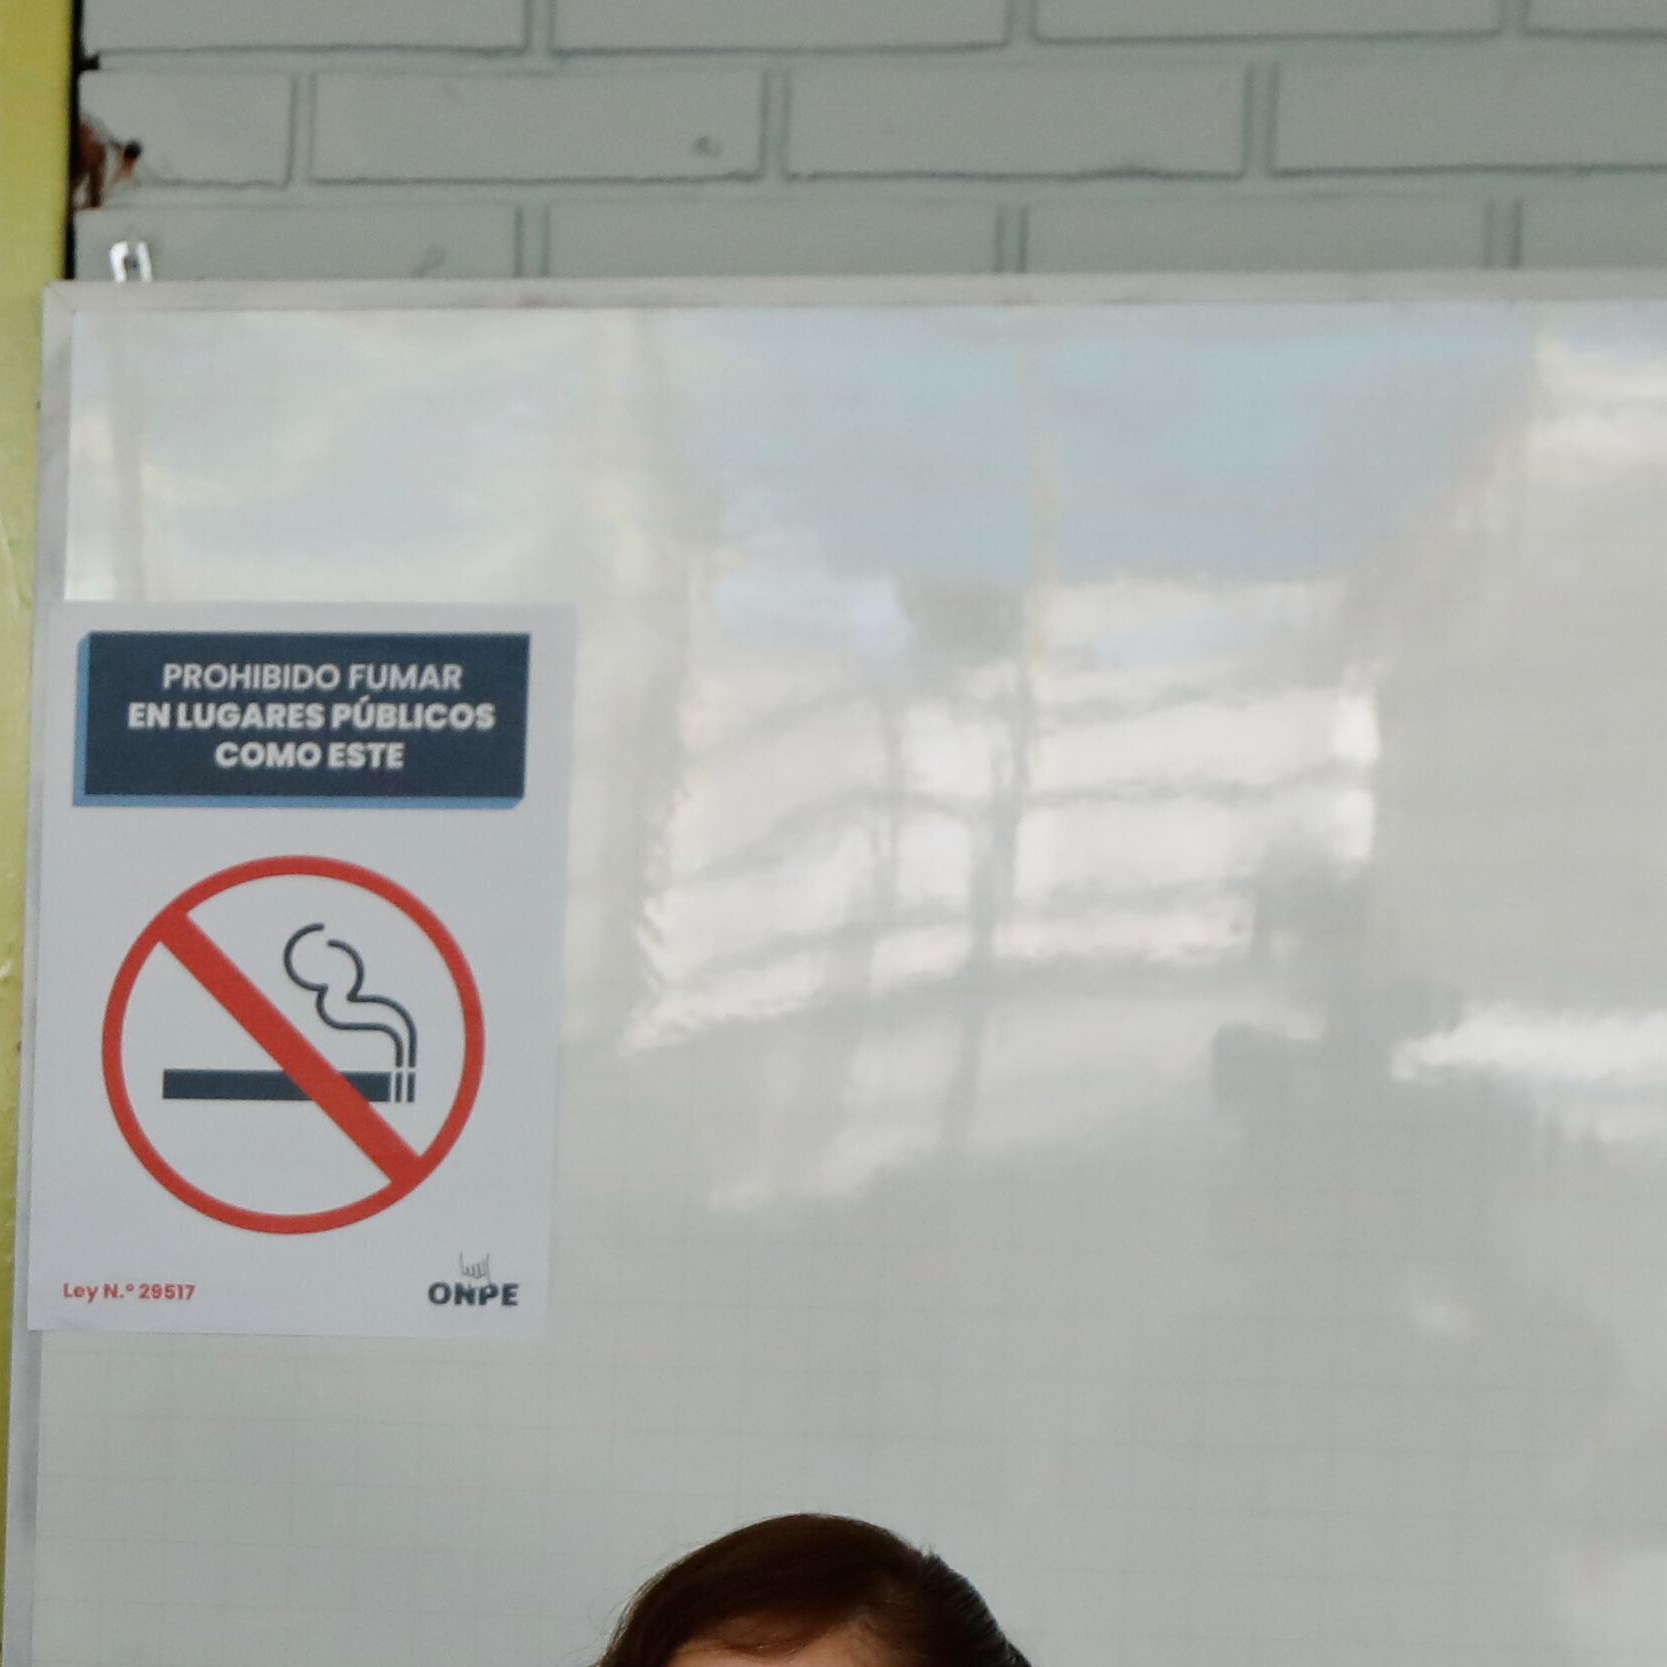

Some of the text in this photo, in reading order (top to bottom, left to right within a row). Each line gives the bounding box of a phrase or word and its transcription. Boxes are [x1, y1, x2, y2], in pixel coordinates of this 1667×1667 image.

[162, 663, 463, 690] PROHIBIDO FUMAR
[128, 697, 496, 732] EN LUGARES PÚBLICOS
[215, 741, 405, 770] COMO ESTE
[62, 1281, 99, 1302] Ley
[139, 1282, 196, 1301] 29517
[428, 1283, 520, 1307] ONPE
